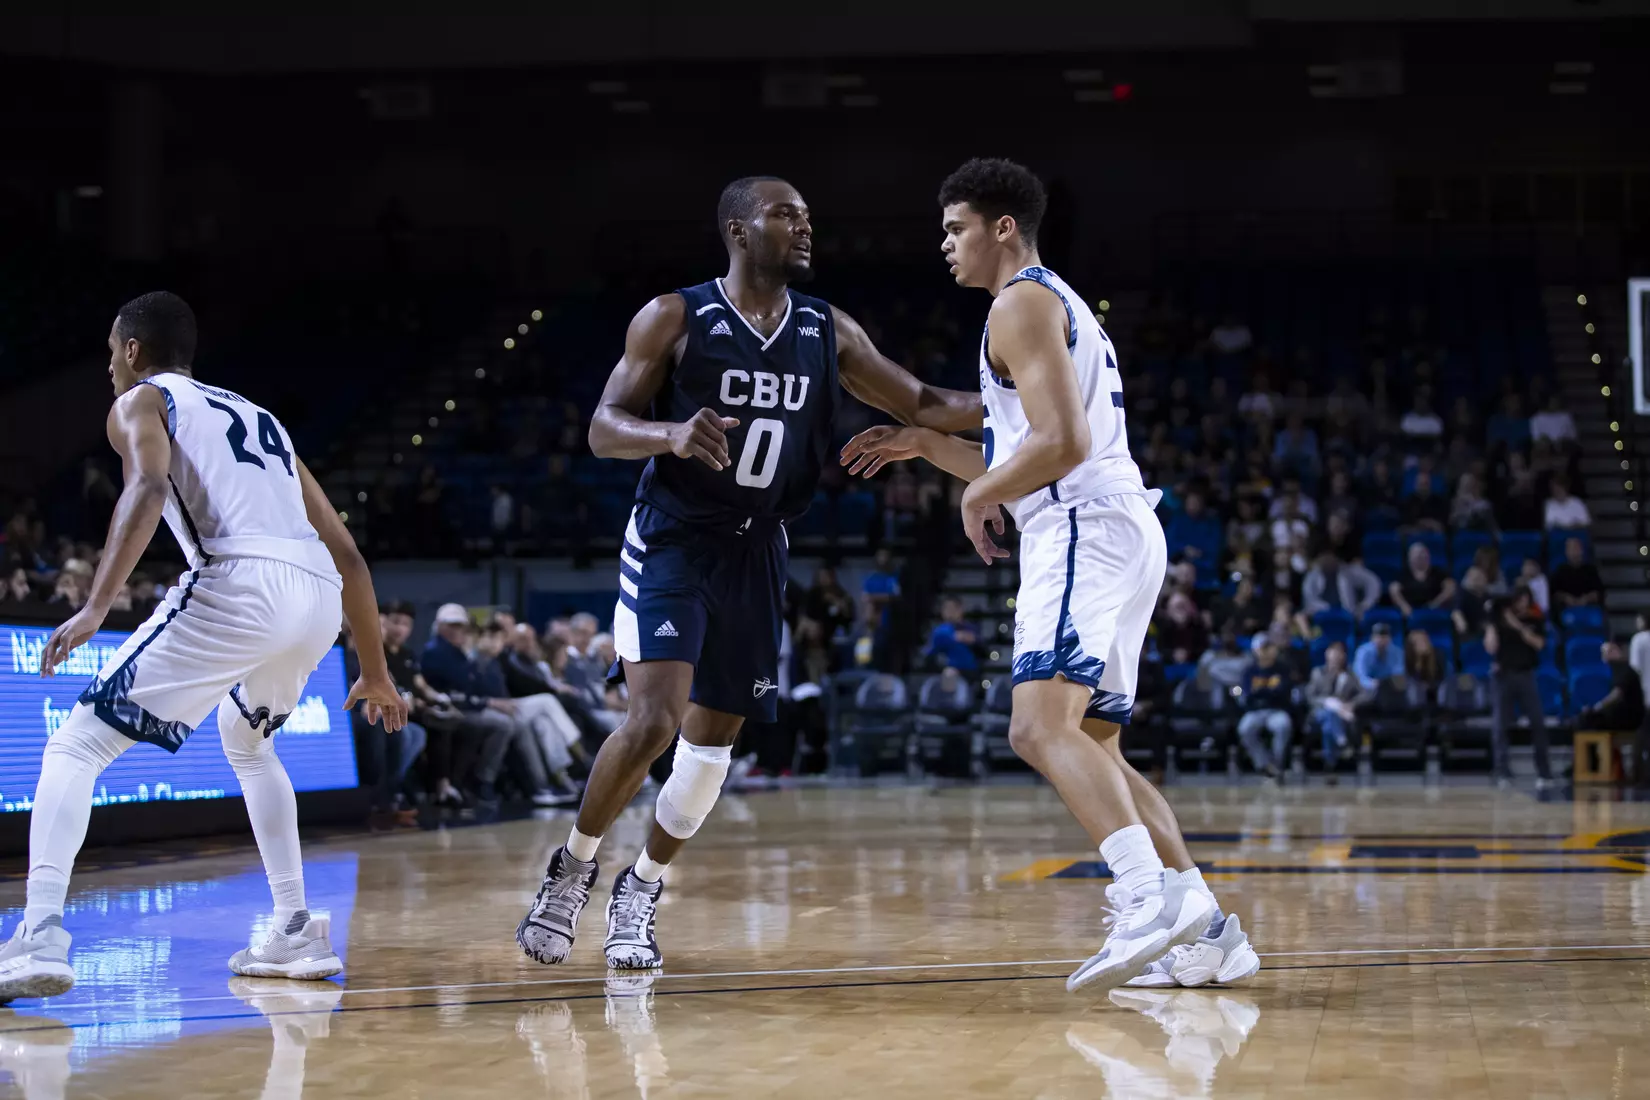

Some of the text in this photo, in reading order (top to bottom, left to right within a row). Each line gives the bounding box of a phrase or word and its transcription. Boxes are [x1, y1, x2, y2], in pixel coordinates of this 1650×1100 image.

[709, 328, 733, 337] adidas
[797, 326, 820, 338] WAC
[719, 368, 810, 411] CBU
[204, 396, 294, 478] 24
[735, 417, 785, 489] 0
[654, 629, 679, 637] adidas
